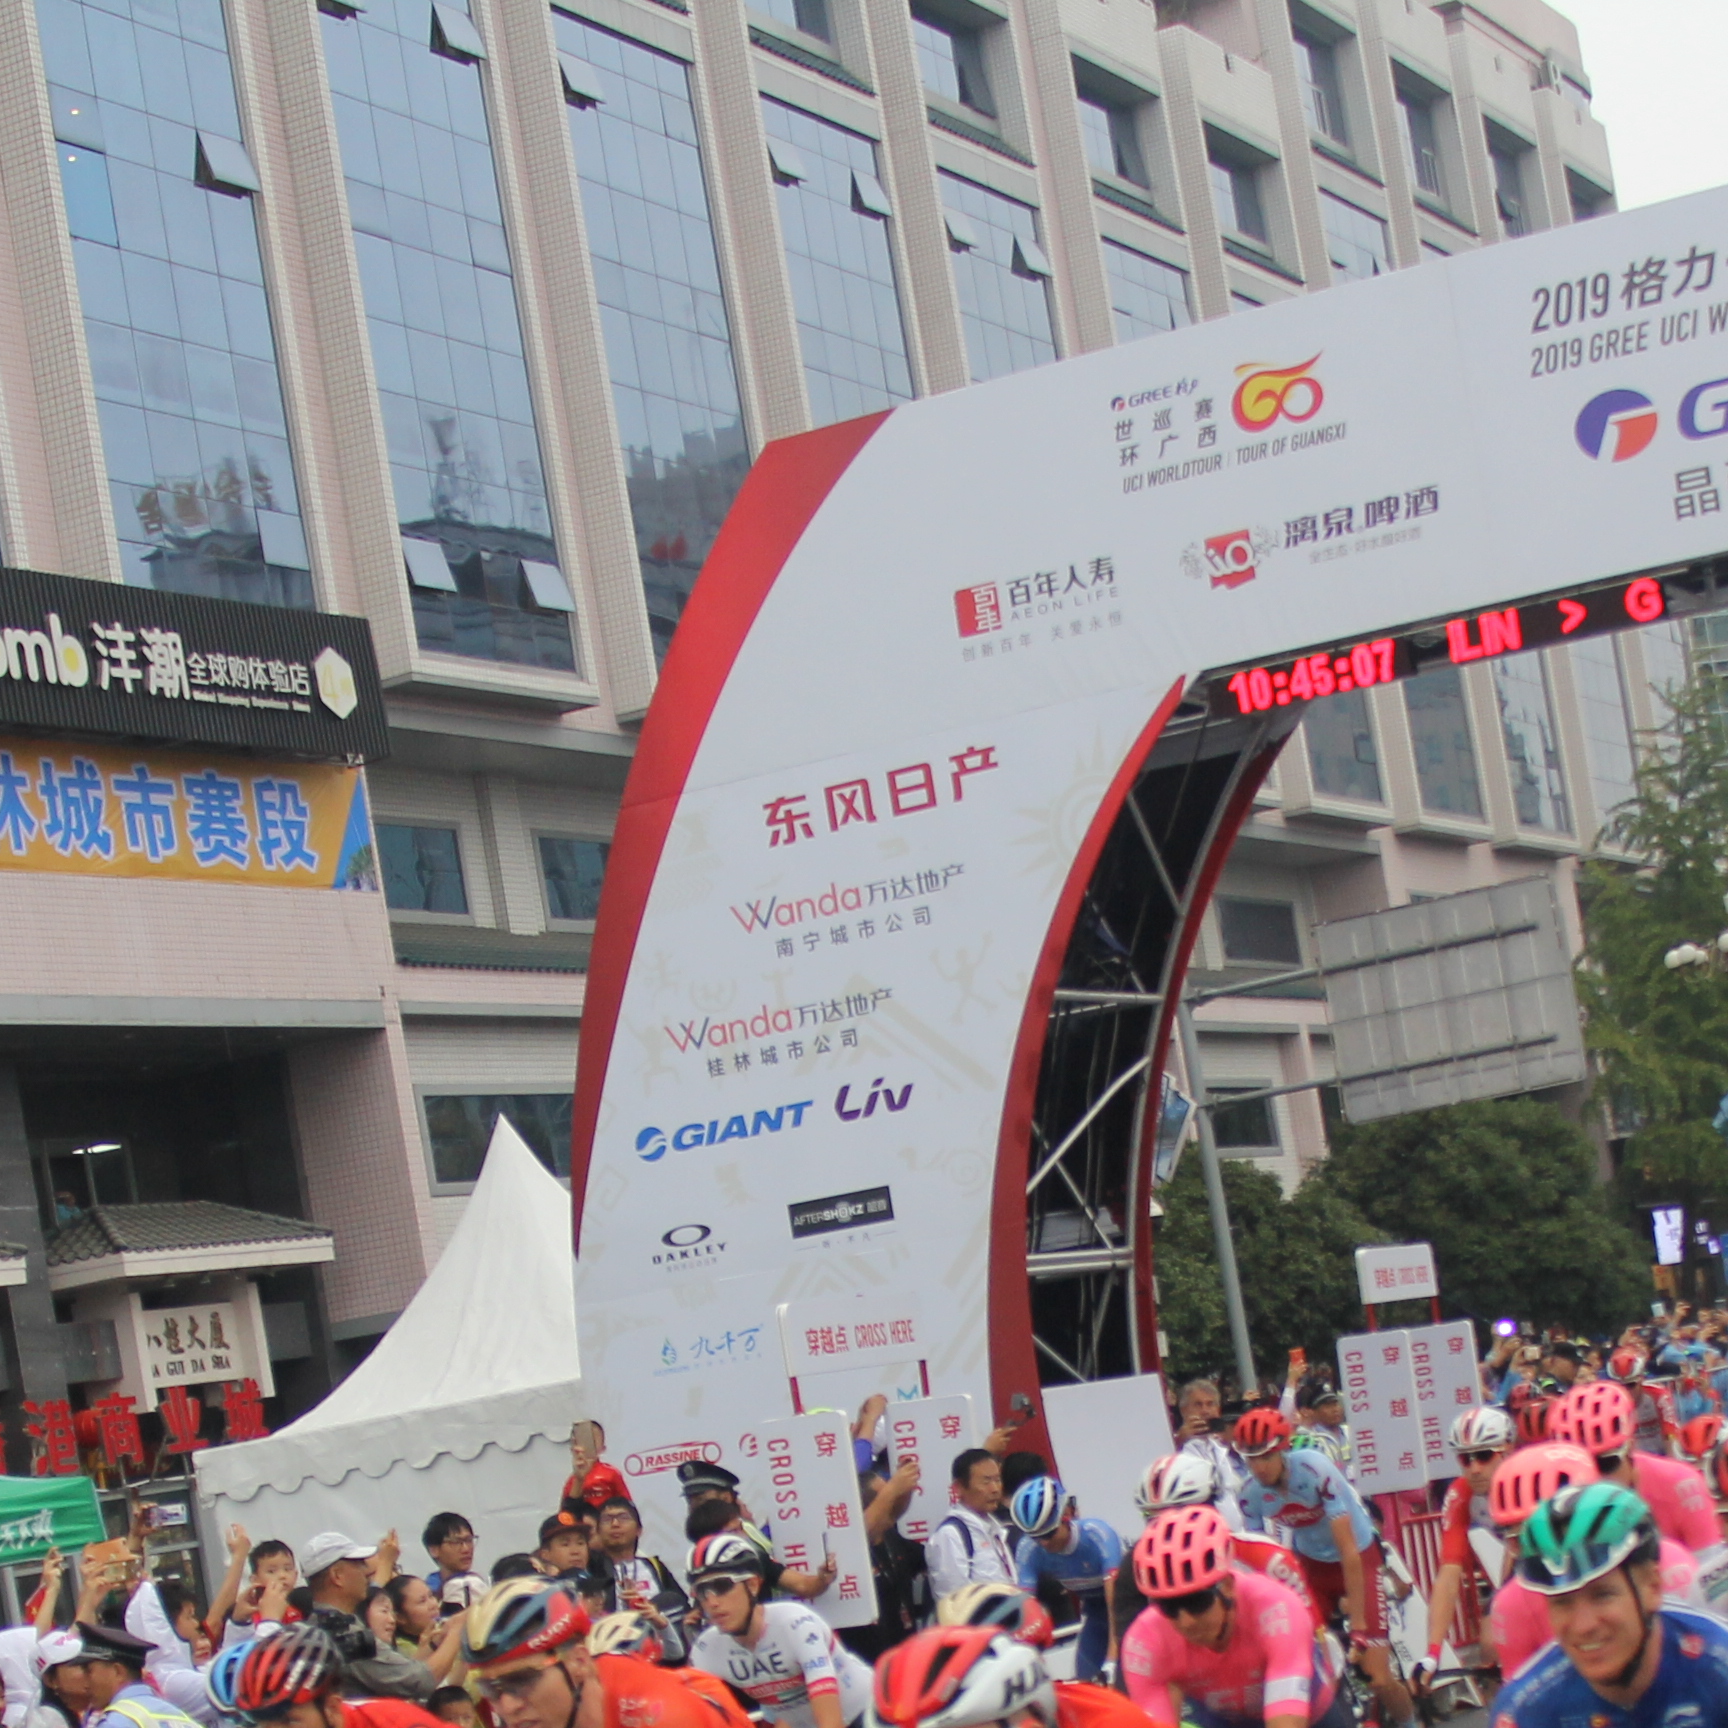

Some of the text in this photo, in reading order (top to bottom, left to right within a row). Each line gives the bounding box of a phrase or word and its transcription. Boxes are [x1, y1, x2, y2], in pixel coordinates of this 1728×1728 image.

[1531, 273, 1610, 333] 2019
[1530, 341, 1583, 378] 2019
[1589, 321, 1649, 362] GREE
[1661, 309, 1698, 344] UCI
[1114, 397, 1214, 443] 世巡赛
[1119, 425, 1217, 468] 环广西
[1122, 422, 1347, 494] UCI WORLDTOUR TOUR OF GUANGXI
[1005, 556, 1115, 608] 百年人寿
[1010, 586, 1119, 622] AEON LIFE
[1445, 576, 1663, 664] LIN G
[187, 652, 311, 697] 全球购体验店
[1228, 637, 1396, 715] 10:45:07
[762, 745, 1000, 848] 东风日产
[729, 863, 965, 934] Wanda 万达地产
[775, 905, 932, 958] 南宁城市公司
[663, 987, 894, 1054] Wanda 万达地产
[706, 1027, 859, 1078] 桂林城市公司
[672, 1077, 914, 1153] GIANT Liv
[793, 1203, 864, 1227] AFTERSHOKZ
[651, 1241, 727, 1265] OAKLEY
[805, 1317, 916, 1358] 穿越点 CROSS HERE
[1412, 1341, 1445, 1463] CROSS HERE
[1446, 1336, 1473, 1406] 穿越
[1344, 1350, 1379, 1478] CROSS HERE
[1382, 1345, 1417, 1472] 穿越点
[644, 1445, 702, 1469] RASSINE
[767, 1437, 801, 1522] CROSS
[814, 1430, 861, 1600] 穿越点
[525, 1611, 576, 1651] RUDY
[727, 1649, 790, 1682] UAE
